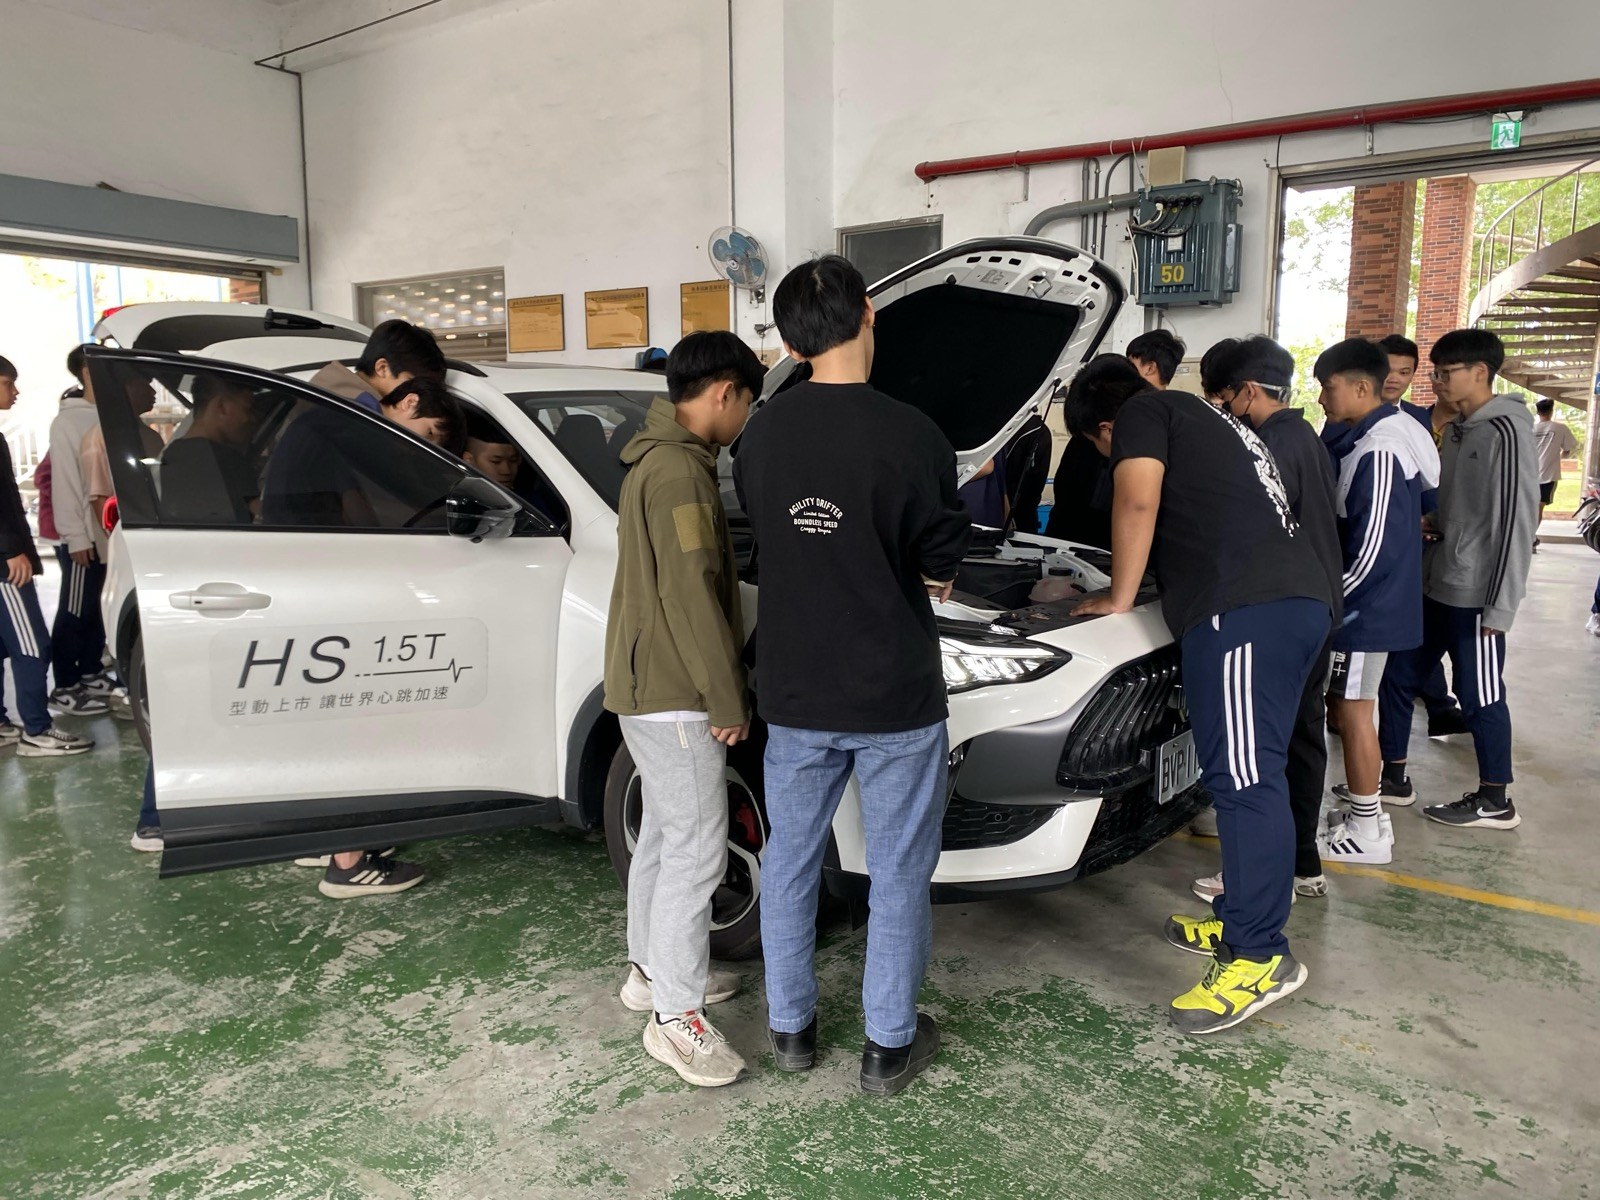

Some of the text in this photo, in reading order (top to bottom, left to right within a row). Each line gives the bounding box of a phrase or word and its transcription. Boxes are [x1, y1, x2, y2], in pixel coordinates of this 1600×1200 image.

[1161, 265, 1185, 283] 50
[789, 497, 843, 520] AGILITY DRIFTER
[793, 518, 838, 528] BOUNDLESS SPEED
[237, 633, 446, 689] HS 1.5T
[228, 686, 449, 717] 型動上市 讓世界心跳加速
